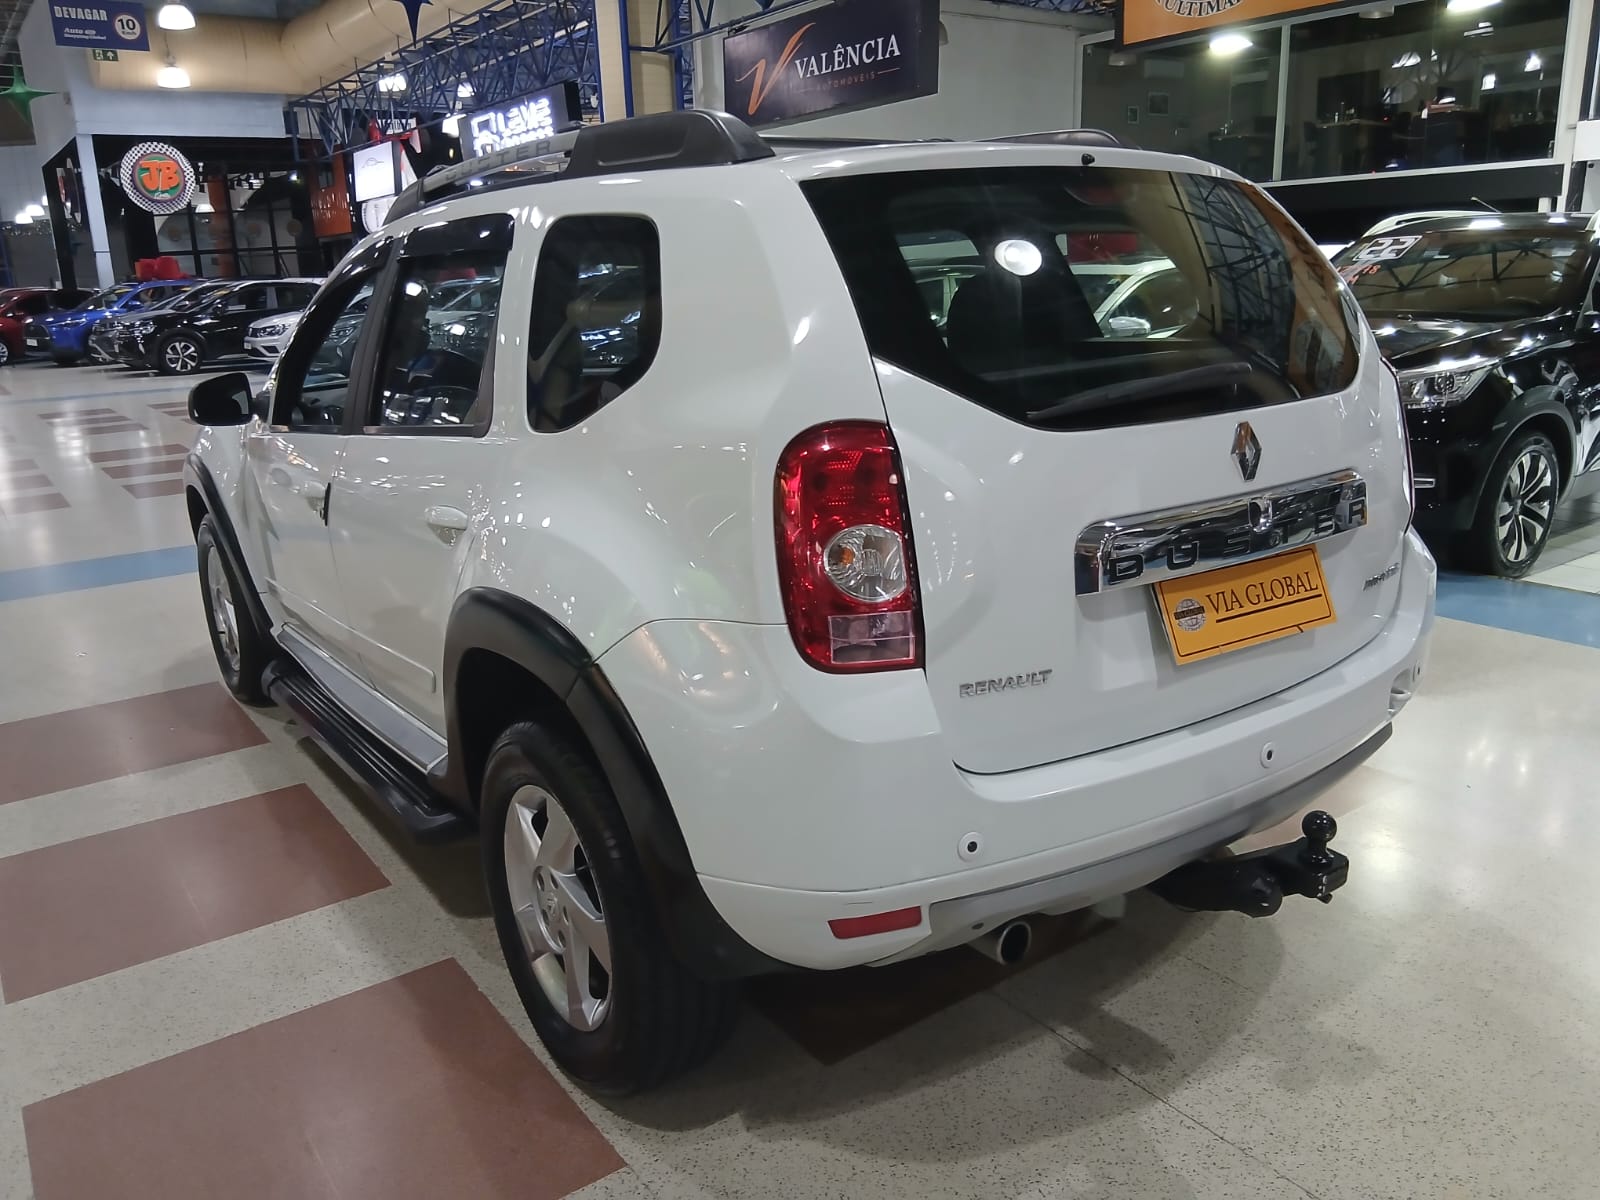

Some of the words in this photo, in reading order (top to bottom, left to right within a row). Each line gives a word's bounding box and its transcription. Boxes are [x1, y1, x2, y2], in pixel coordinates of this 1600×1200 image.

[54, 6, 108, 21] DEVAGAR
[117, 18, 136, 31] 10
[794, 34, 901, 79] VALÊNCIA
[140, 160, 179, 191] JB
[1357, 238, 1417, 259] 22
[1108, 498, 1367, 586] DUSTER
[1205, 588, 1244, 615] VIA
[1245, 571, 1319, 606] GLOBAL
[959, 668, 1053, 698] RENAULT
